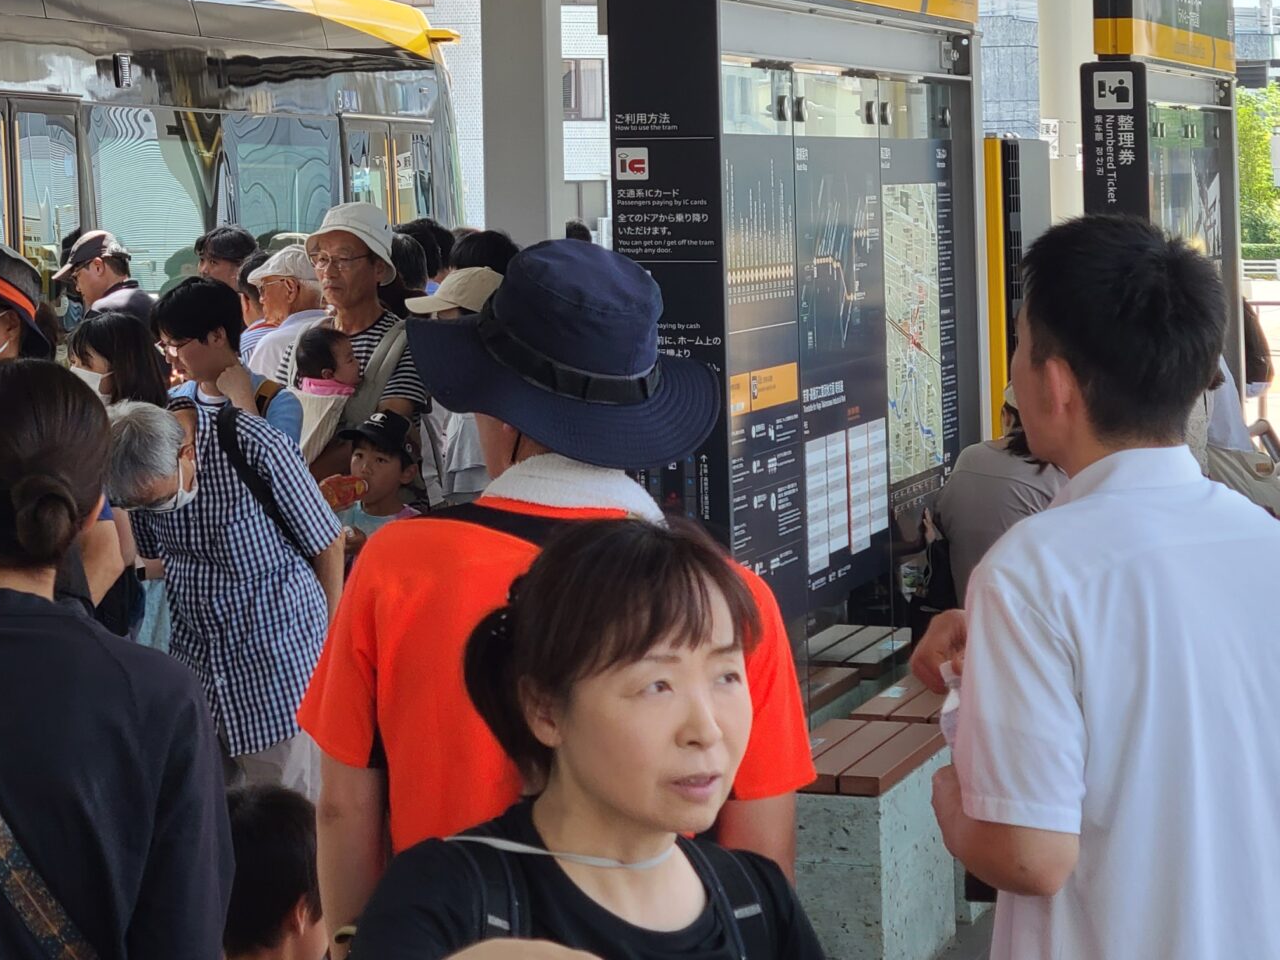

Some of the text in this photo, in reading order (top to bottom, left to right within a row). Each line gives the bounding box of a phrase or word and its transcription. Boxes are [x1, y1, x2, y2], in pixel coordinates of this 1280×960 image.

[615, 112, 670, 125] ご利用方法
[1117, 114, 1136, 165] 整理券
[1106, 114, 1117, 203] Numbered Ticket
[617, 199, 651, 207] Passengers
[652, 199, 673, 207] paying
[677, 322, 685, 330] by
